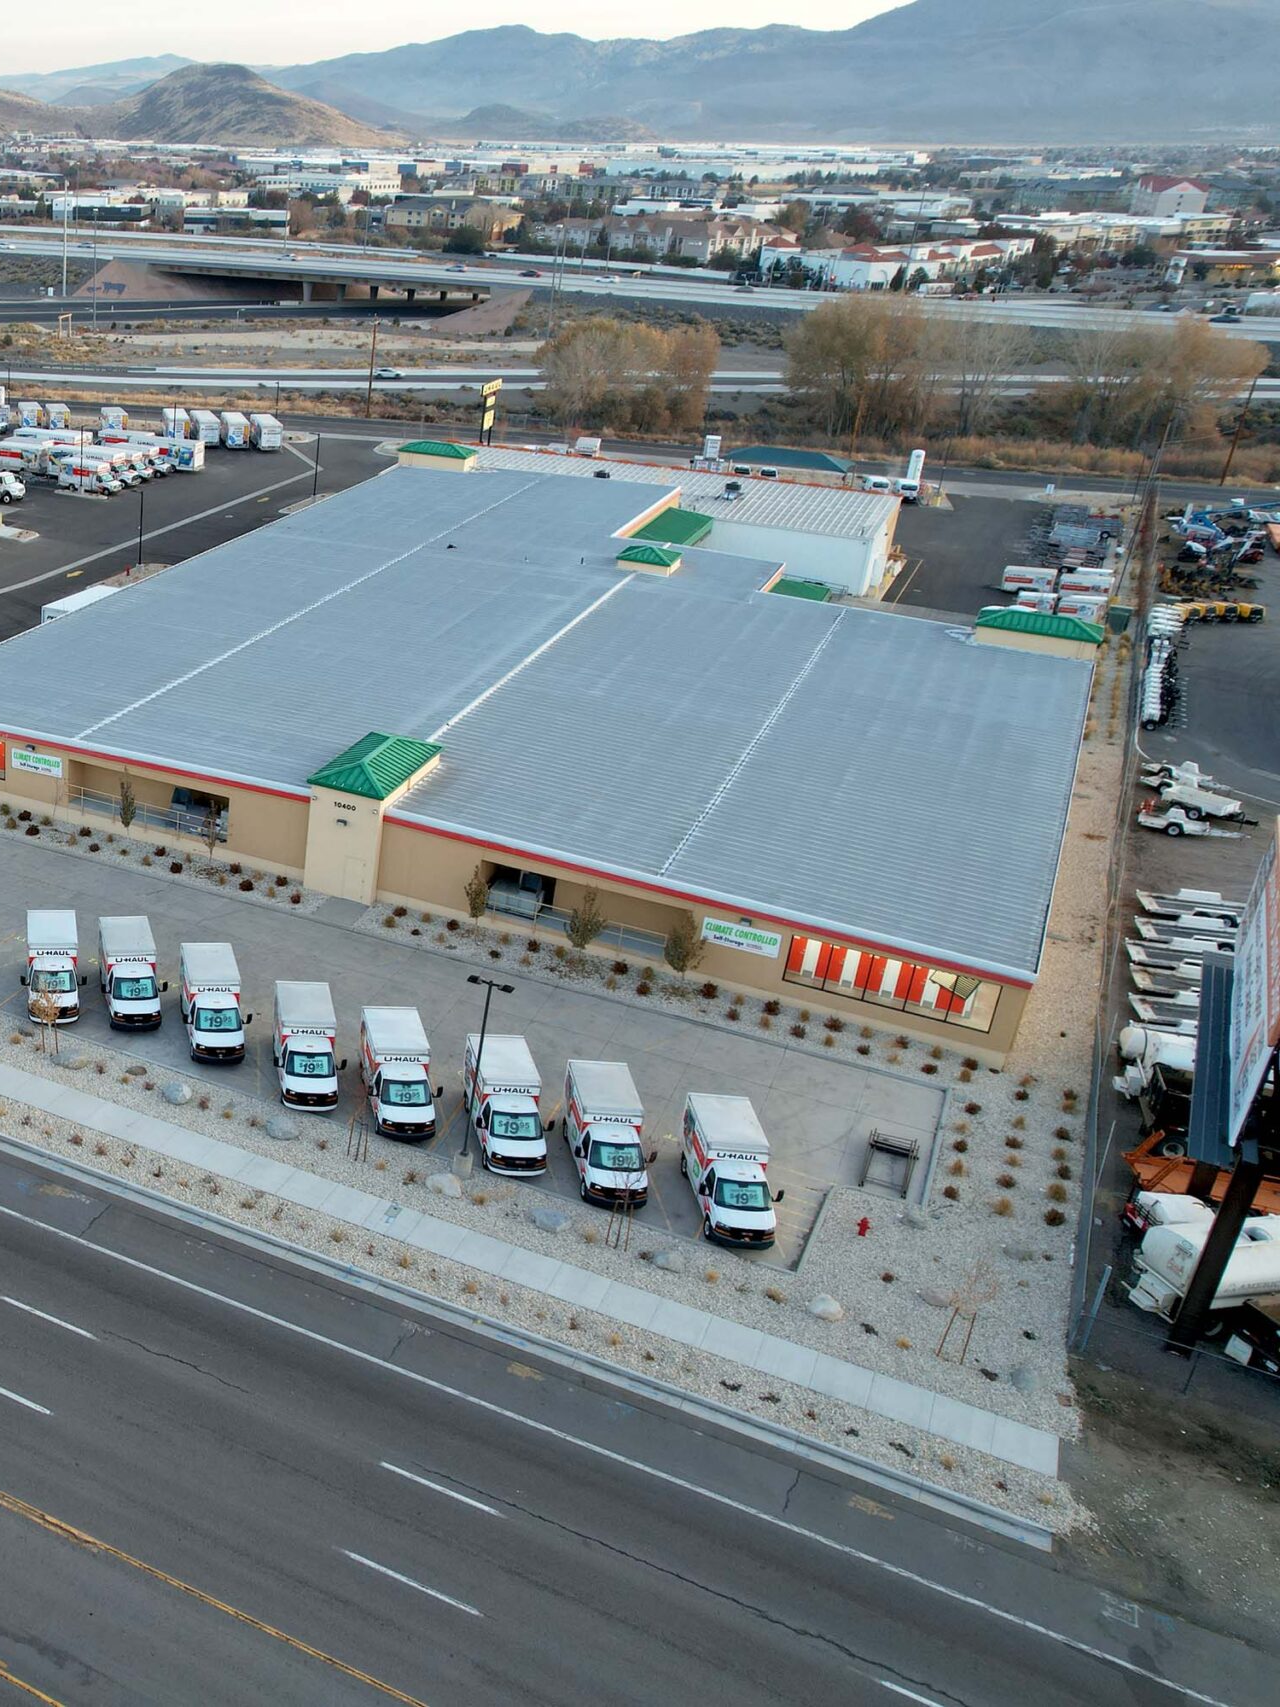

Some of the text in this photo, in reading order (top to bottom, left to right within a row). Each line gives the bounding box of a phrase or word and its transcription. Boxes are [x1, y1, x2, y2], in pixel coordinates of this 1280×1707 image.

[333, 801, 357, 812] 10400
[705, 921, 778, 946] CLIMATE CONTROLLED
[593, 1115, 634, 1124] U-HAUL
[716, 1152, 759, 1161] U-HAUL
